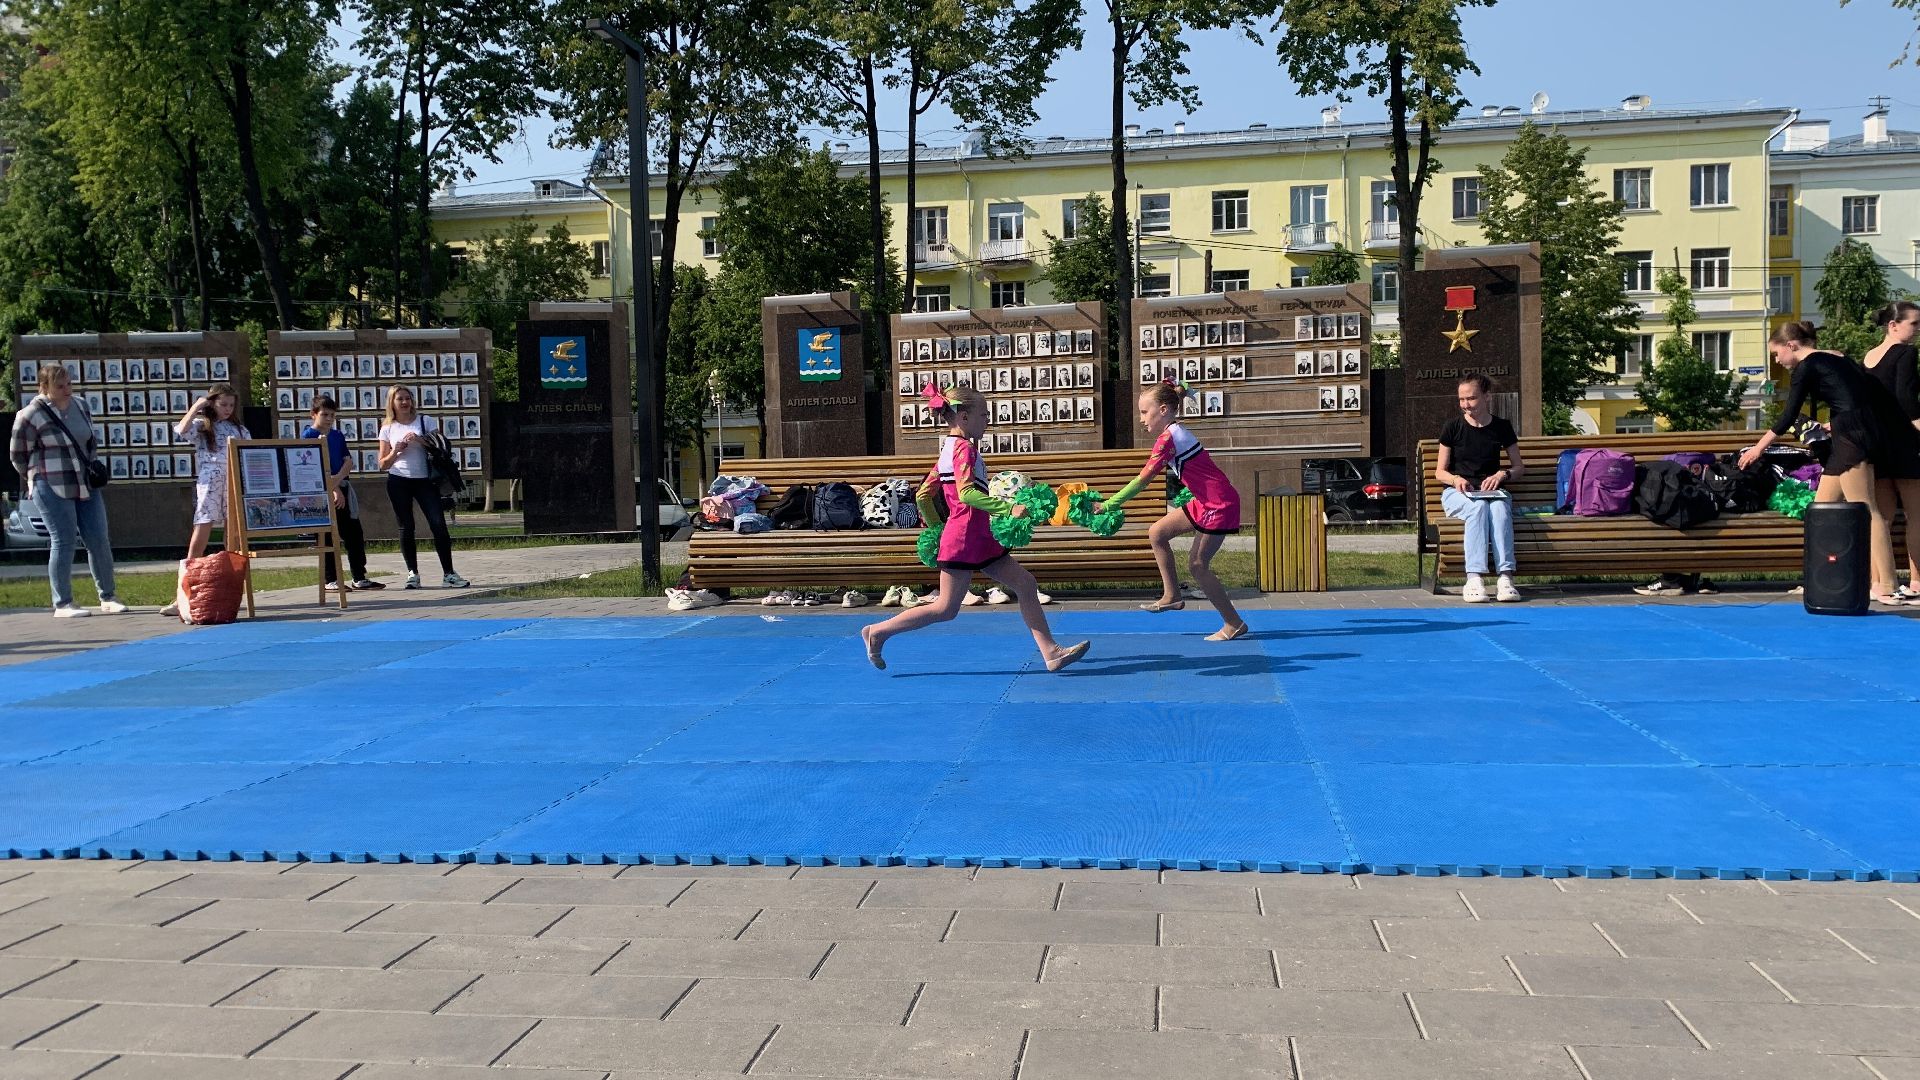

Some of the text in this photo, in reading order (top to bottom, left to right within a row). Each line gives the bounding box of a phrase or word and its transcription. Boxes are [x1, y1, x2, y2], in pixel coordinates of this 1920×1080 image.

[1280, 299, 1347, 311] ГЕРОИ ТРУДА
[1153, 304, 1258, 319] ПОЧЕТНЫЕ ГРАЖДАНЕ
[1416, 368, 1459, 378] АЛЛЕЯ
[787, 396, 857, 407] АЛЛЕЯ СЛАВЫ
[527, 403, 603, 413] АЛЛЕЯ СЛАВЫ
